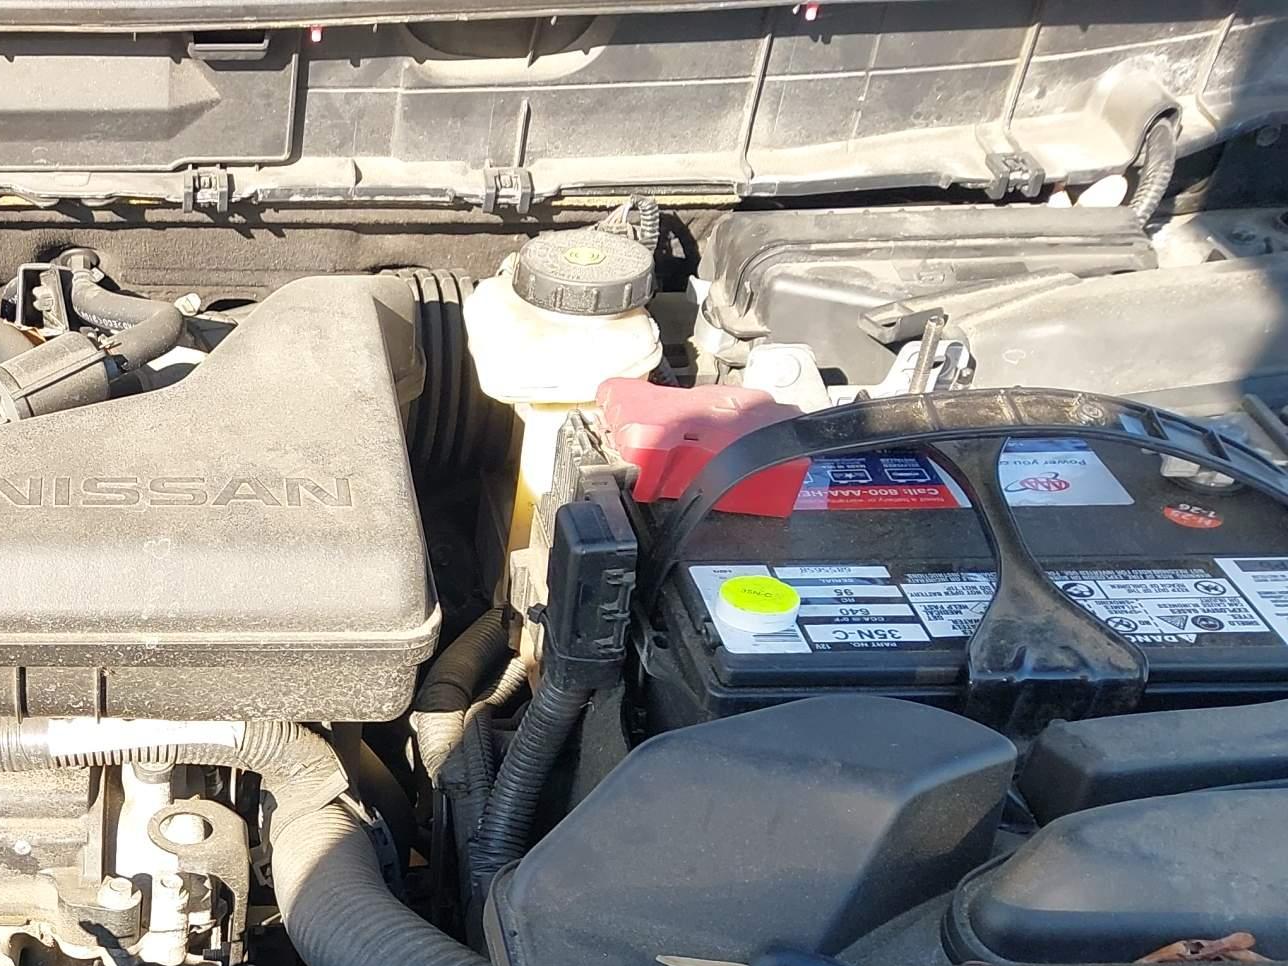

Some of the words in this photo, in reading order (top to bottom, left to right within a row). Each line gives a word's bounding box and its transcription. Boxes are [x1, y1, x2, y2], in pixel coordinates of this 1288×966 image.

[902, 488, 940, 496] Call:
[839, 607, 870, 616] 640
[832, 629, 902, 641] 35N-C
